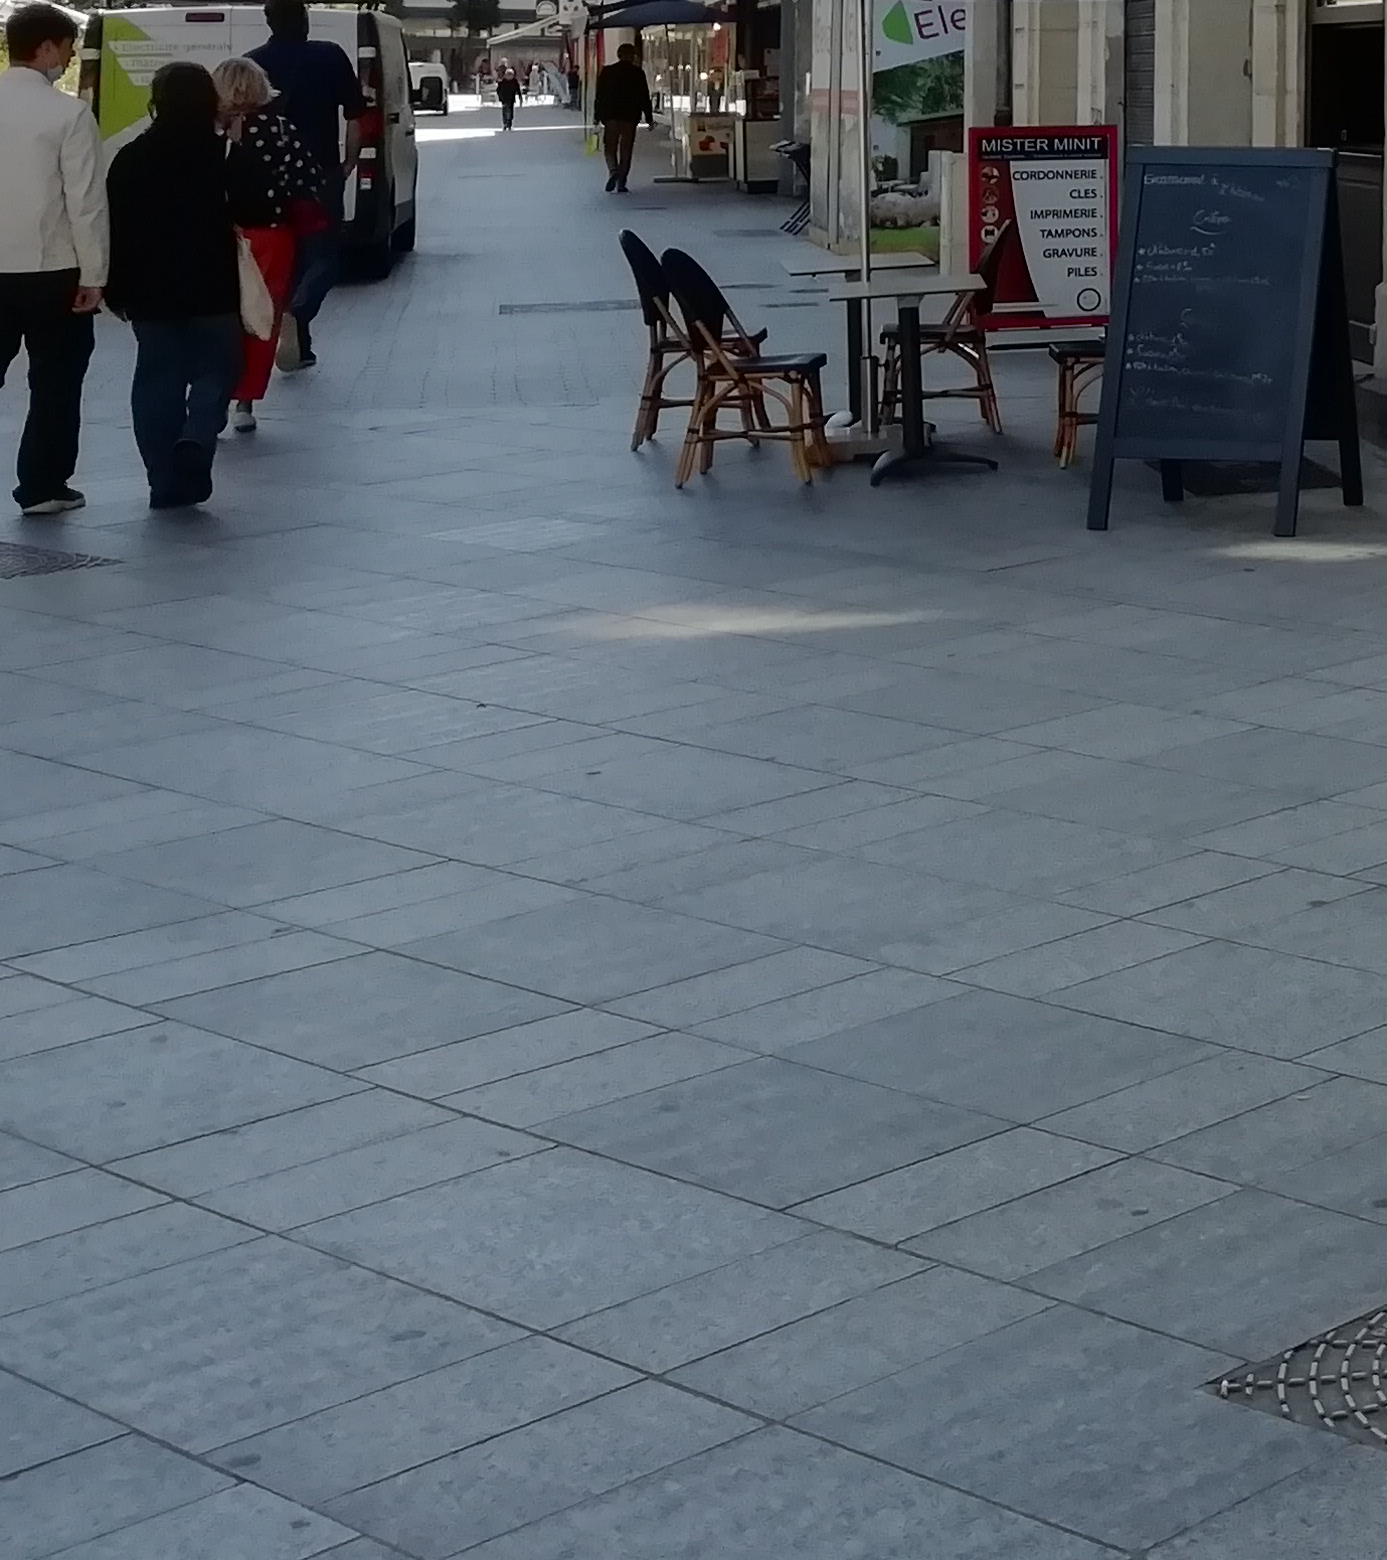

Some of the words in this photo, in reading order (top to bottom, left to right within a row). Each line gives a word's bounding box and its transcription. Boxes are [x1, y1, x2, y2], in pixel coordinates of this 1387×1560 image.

[981, 139, 1048, 152] MISTER
[1054, 137, 1102, 151] MINIT
[1013, 169, 1097, 181] CORDONNERIE
[1069, 189, 1097, 199] CLES
[1030, 208, 1097, 220] IMPRIMERIE
[1040, 228, 1097, 239] TAMPONS
[1043, 247, 1097, 258] GRAVURE
[1067, 267, 1097, 277] PILES
